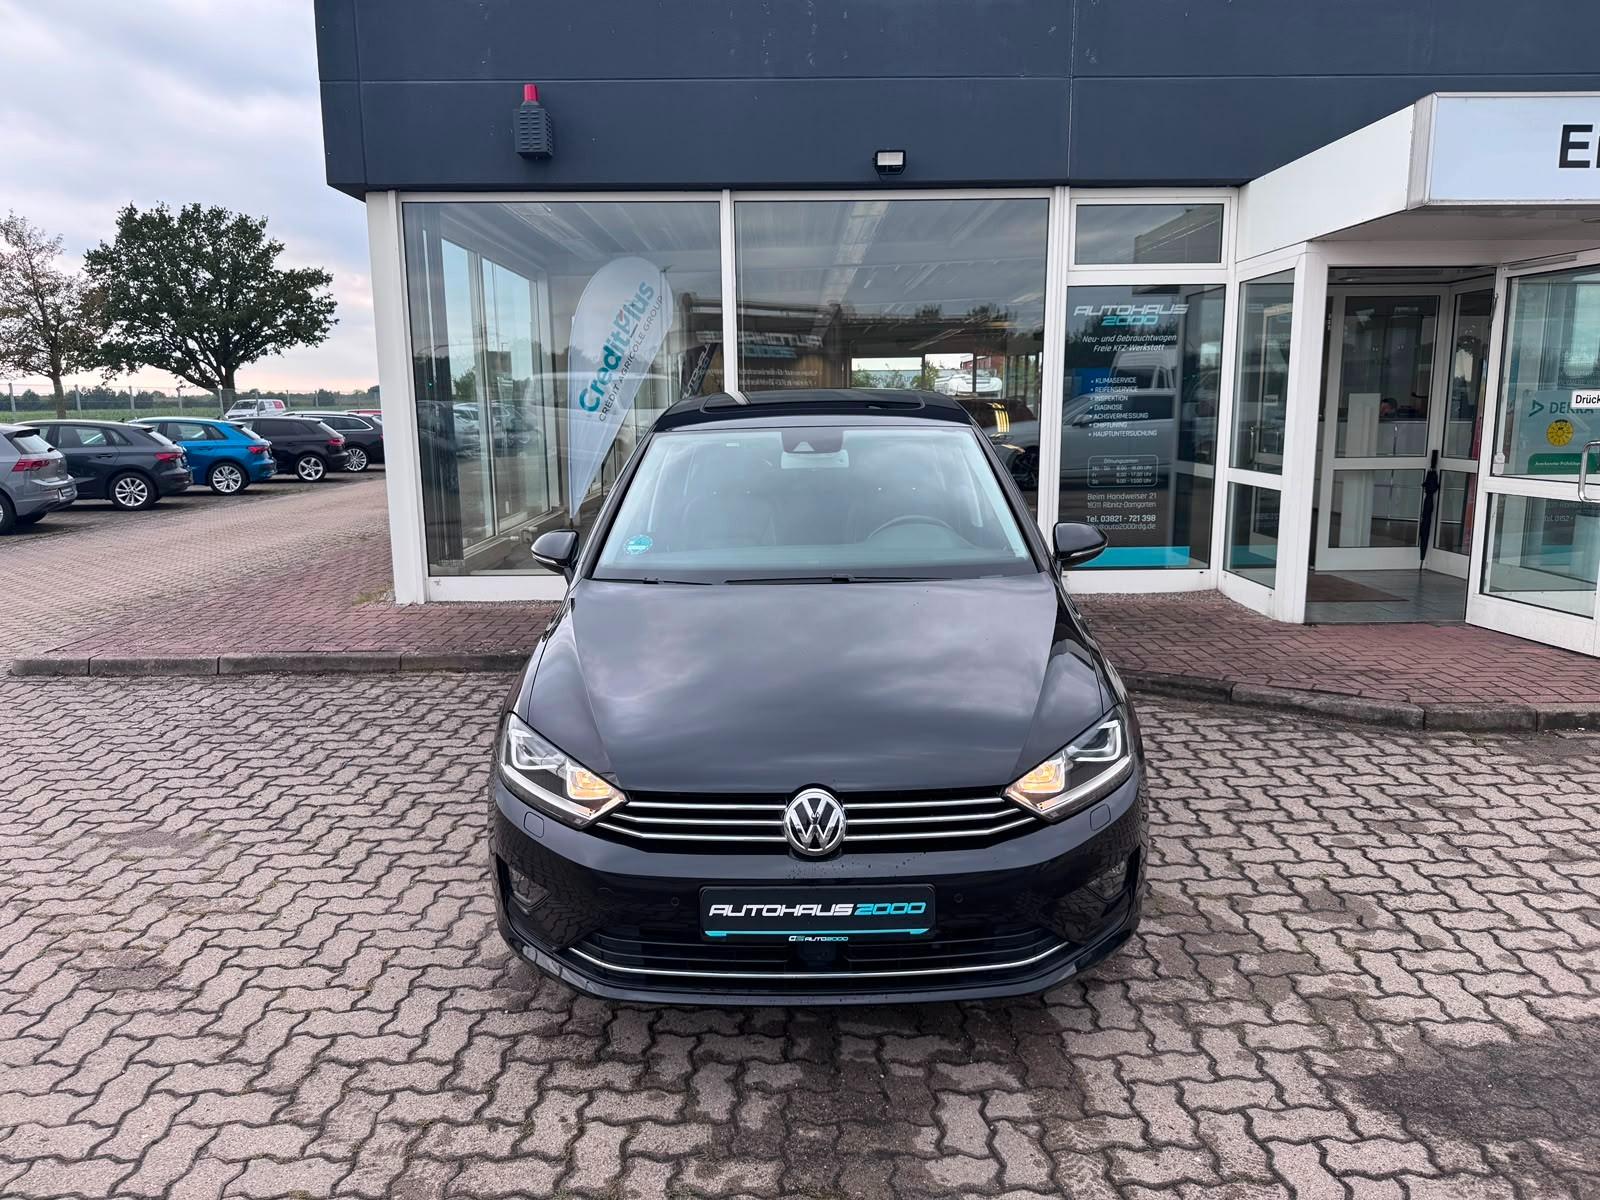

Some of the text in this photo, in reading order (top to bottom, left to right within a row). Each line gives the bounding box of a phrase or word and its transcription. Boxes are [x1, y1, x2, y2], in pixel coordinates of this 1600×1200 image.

[1559, 124, 1600, 168] E
[1073, 304, 1189, 316] AUTOHAUS
[1101, 315, 1159, 326] 2000
[619, 333, 646, 384] AGRICOLE
[644, 295, 663, 334] GROUP
[1082, 334, 1177, 343] Neu- und Gebrauchtwagen
[579, 281, 655, 413] CreditPlus
[1093, 344, 1165, 352] Freie KFZ-Werkstatt
[1087, 493, 1105, 501] Beim
[1128, 514, 1140, 522] 721
[1141, 514, 1156, 522] 398
